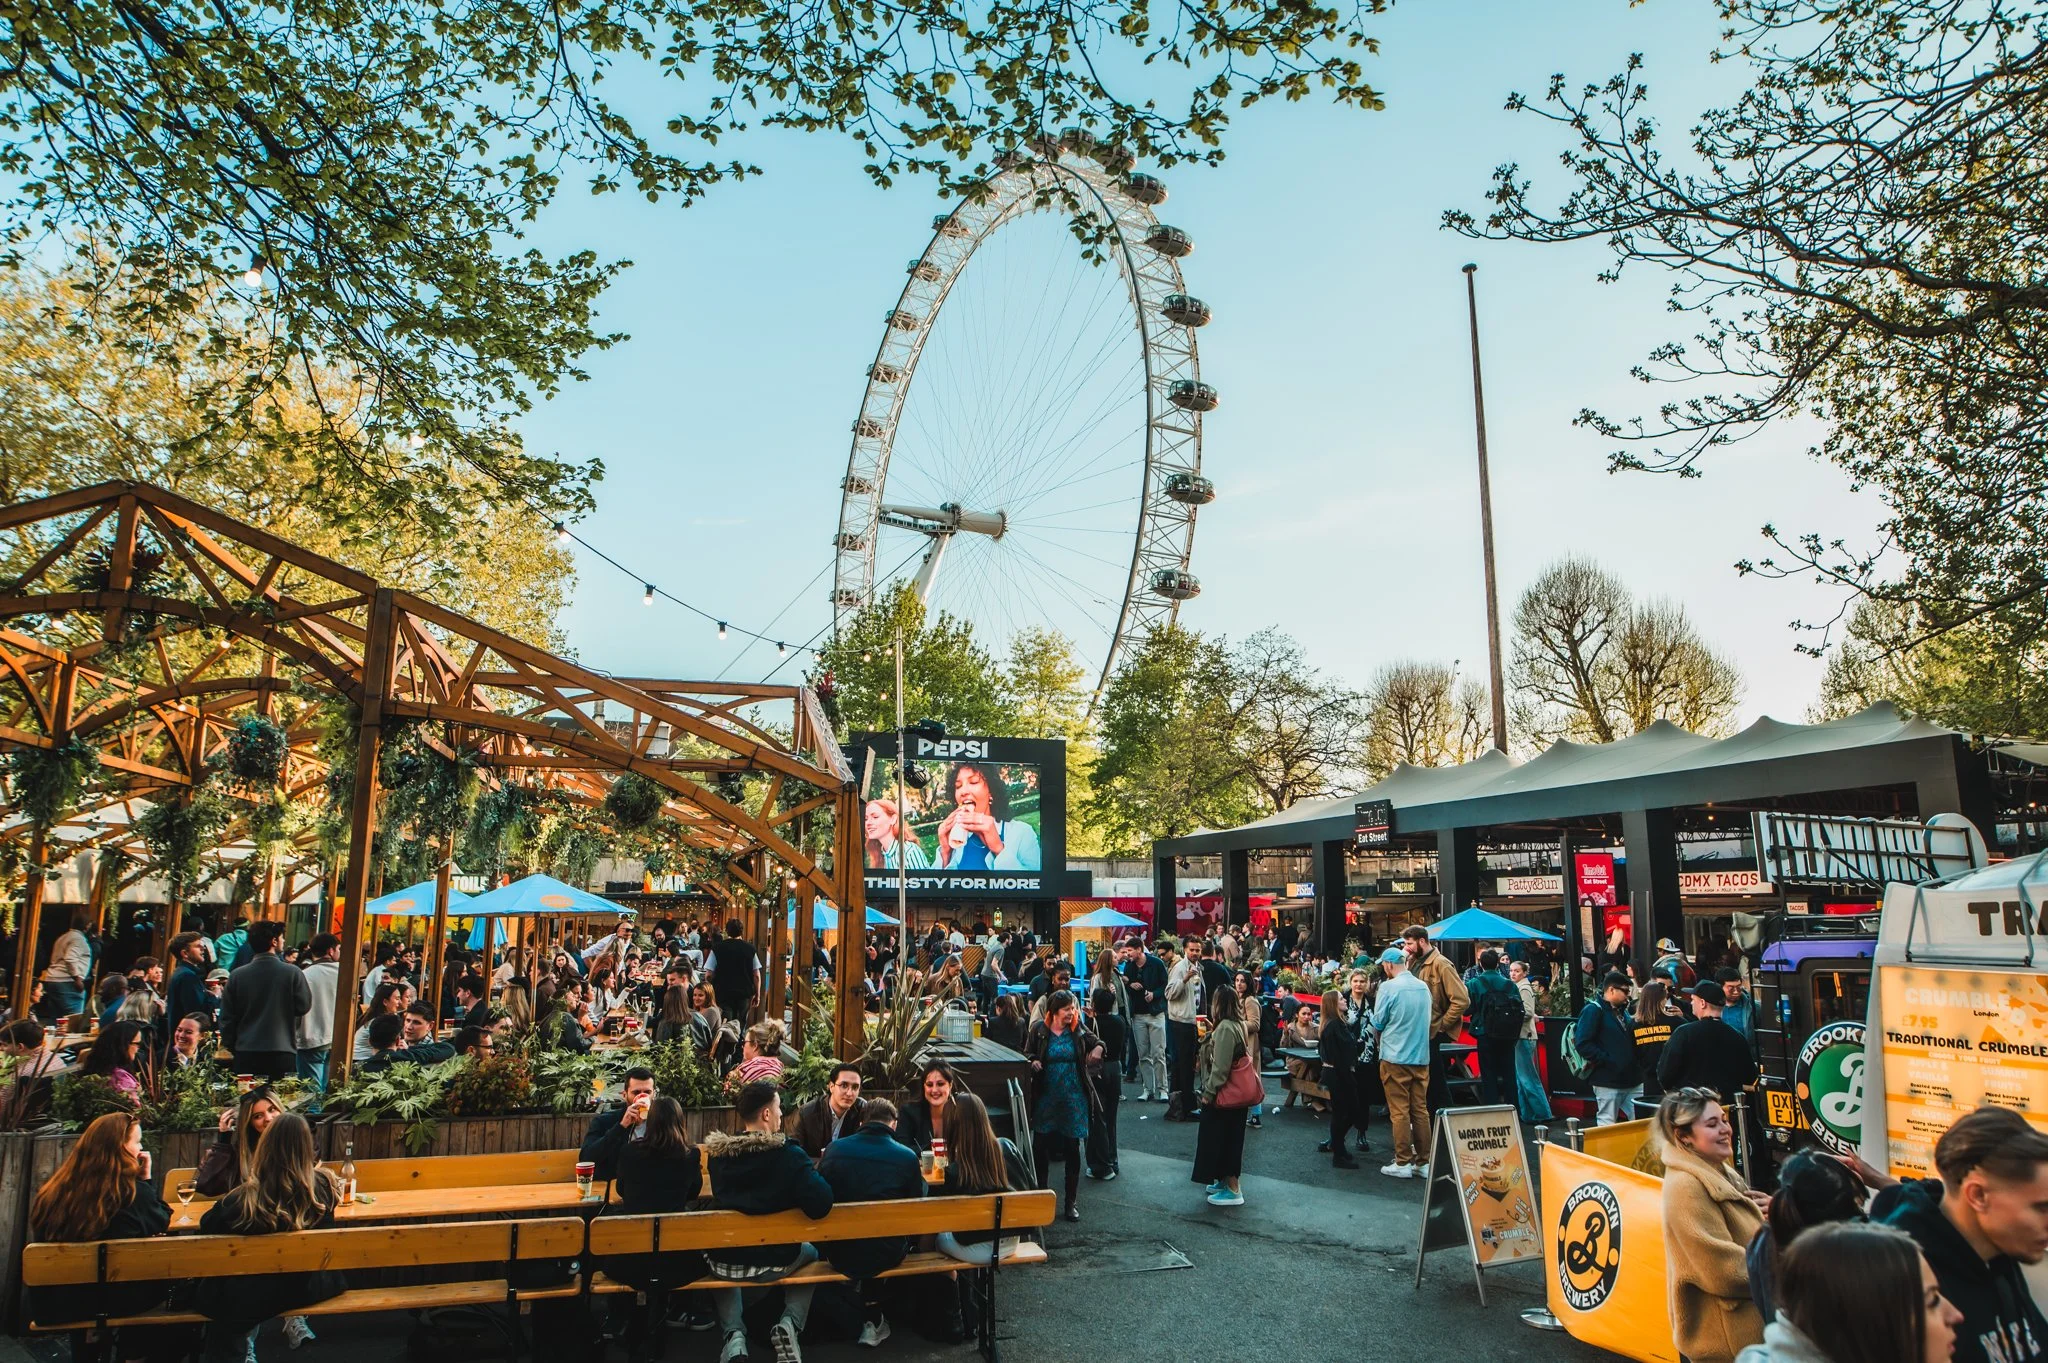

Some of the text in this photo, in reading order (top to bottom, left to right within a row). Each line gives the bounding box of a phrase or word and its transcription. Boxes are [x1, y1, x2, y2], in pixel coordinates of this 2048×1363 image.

[917, 738, 989, 759] PEPSI
[1358, 832, 1387, 843] Eat Street
[452, 876, 503, 891] TOILE
[652, 875, 686, 891] BAR
[864, 877, 1041, 890] THIRSTY FOR MORE
[1679, 873, 1758, 887] CDMX TACOS
[1968, 901, 2048, 936] TR
[1904, 988, 2011, 1010] CRUMBLE
[1902, 1014, 1939, 1029] £7.95
[1973, 1010, 2000, 1018] London
[1886, 1032, 2048, 1058] TRADITIONAL CRUMBLE
[1958, 1054, 1978, 1063] YOUR
[1979, 1055, 2001, 1065] FRUIT
[1458, 1126, 1510, 1140] WARM FRUIT
[1468, 1138, 1508, 1152] CRUMBLE
[1568, 1185, 1619, 1230] BROOKLYN
[1500, 1228, 1530, 1240] CRUMBLE
[1559, 1260, 1606, 1307] BREWERY
